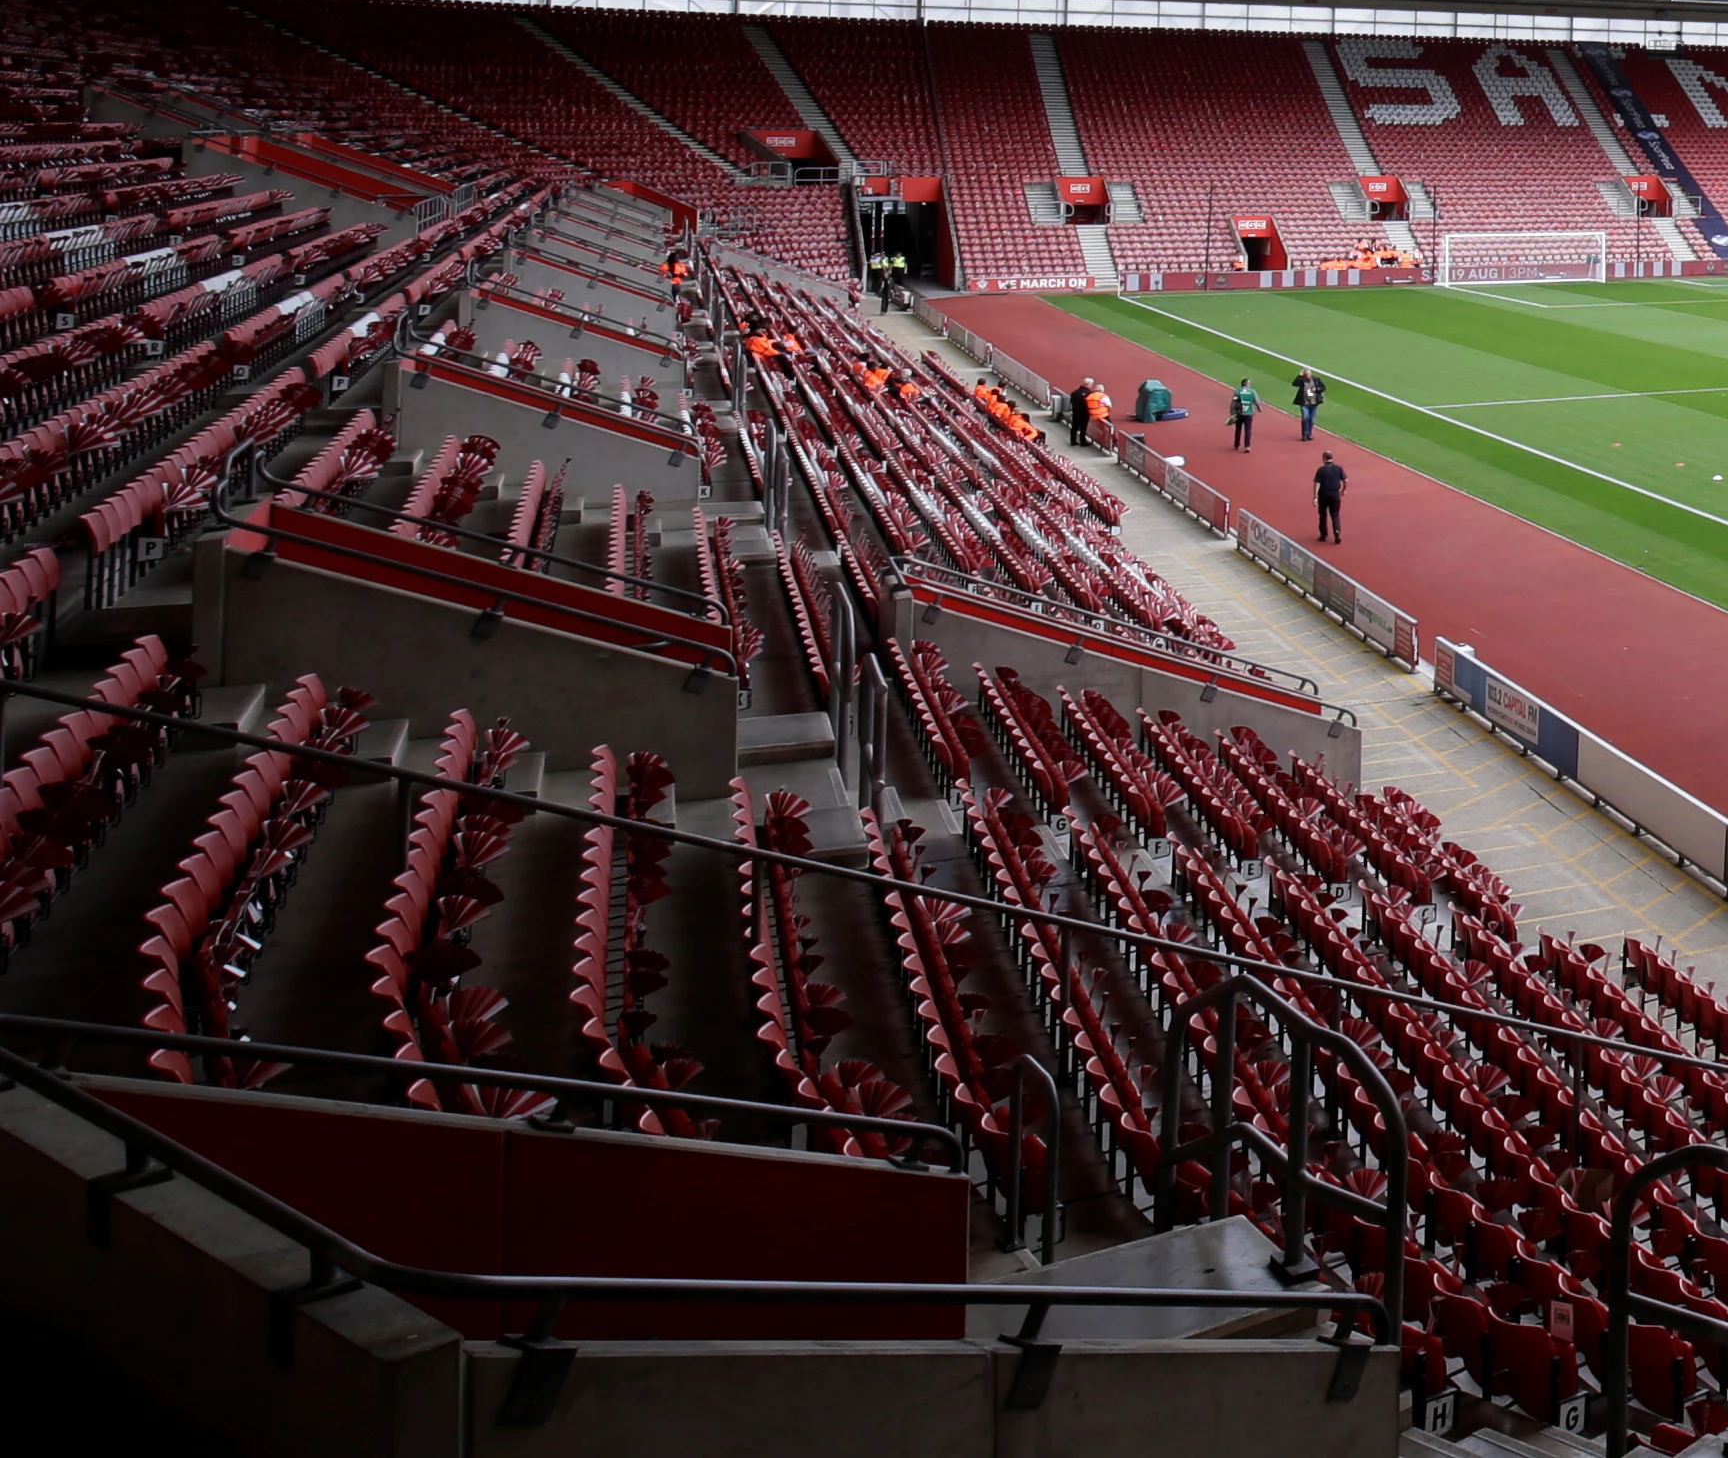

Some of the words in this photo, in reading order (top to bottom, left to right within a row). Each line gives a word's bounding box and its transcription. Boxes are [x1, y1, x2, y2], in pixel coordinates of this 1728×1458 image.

[1452, 268, 1464, 280] 19
[1468, 267, 1499, 280] AUG
[1508, 267, 1537, 279] 3PM
[1020, 278, 1064, 289] MARCH
[1068, 278, 1087, 288] ON
[1056, 818, 1067, 831] G
